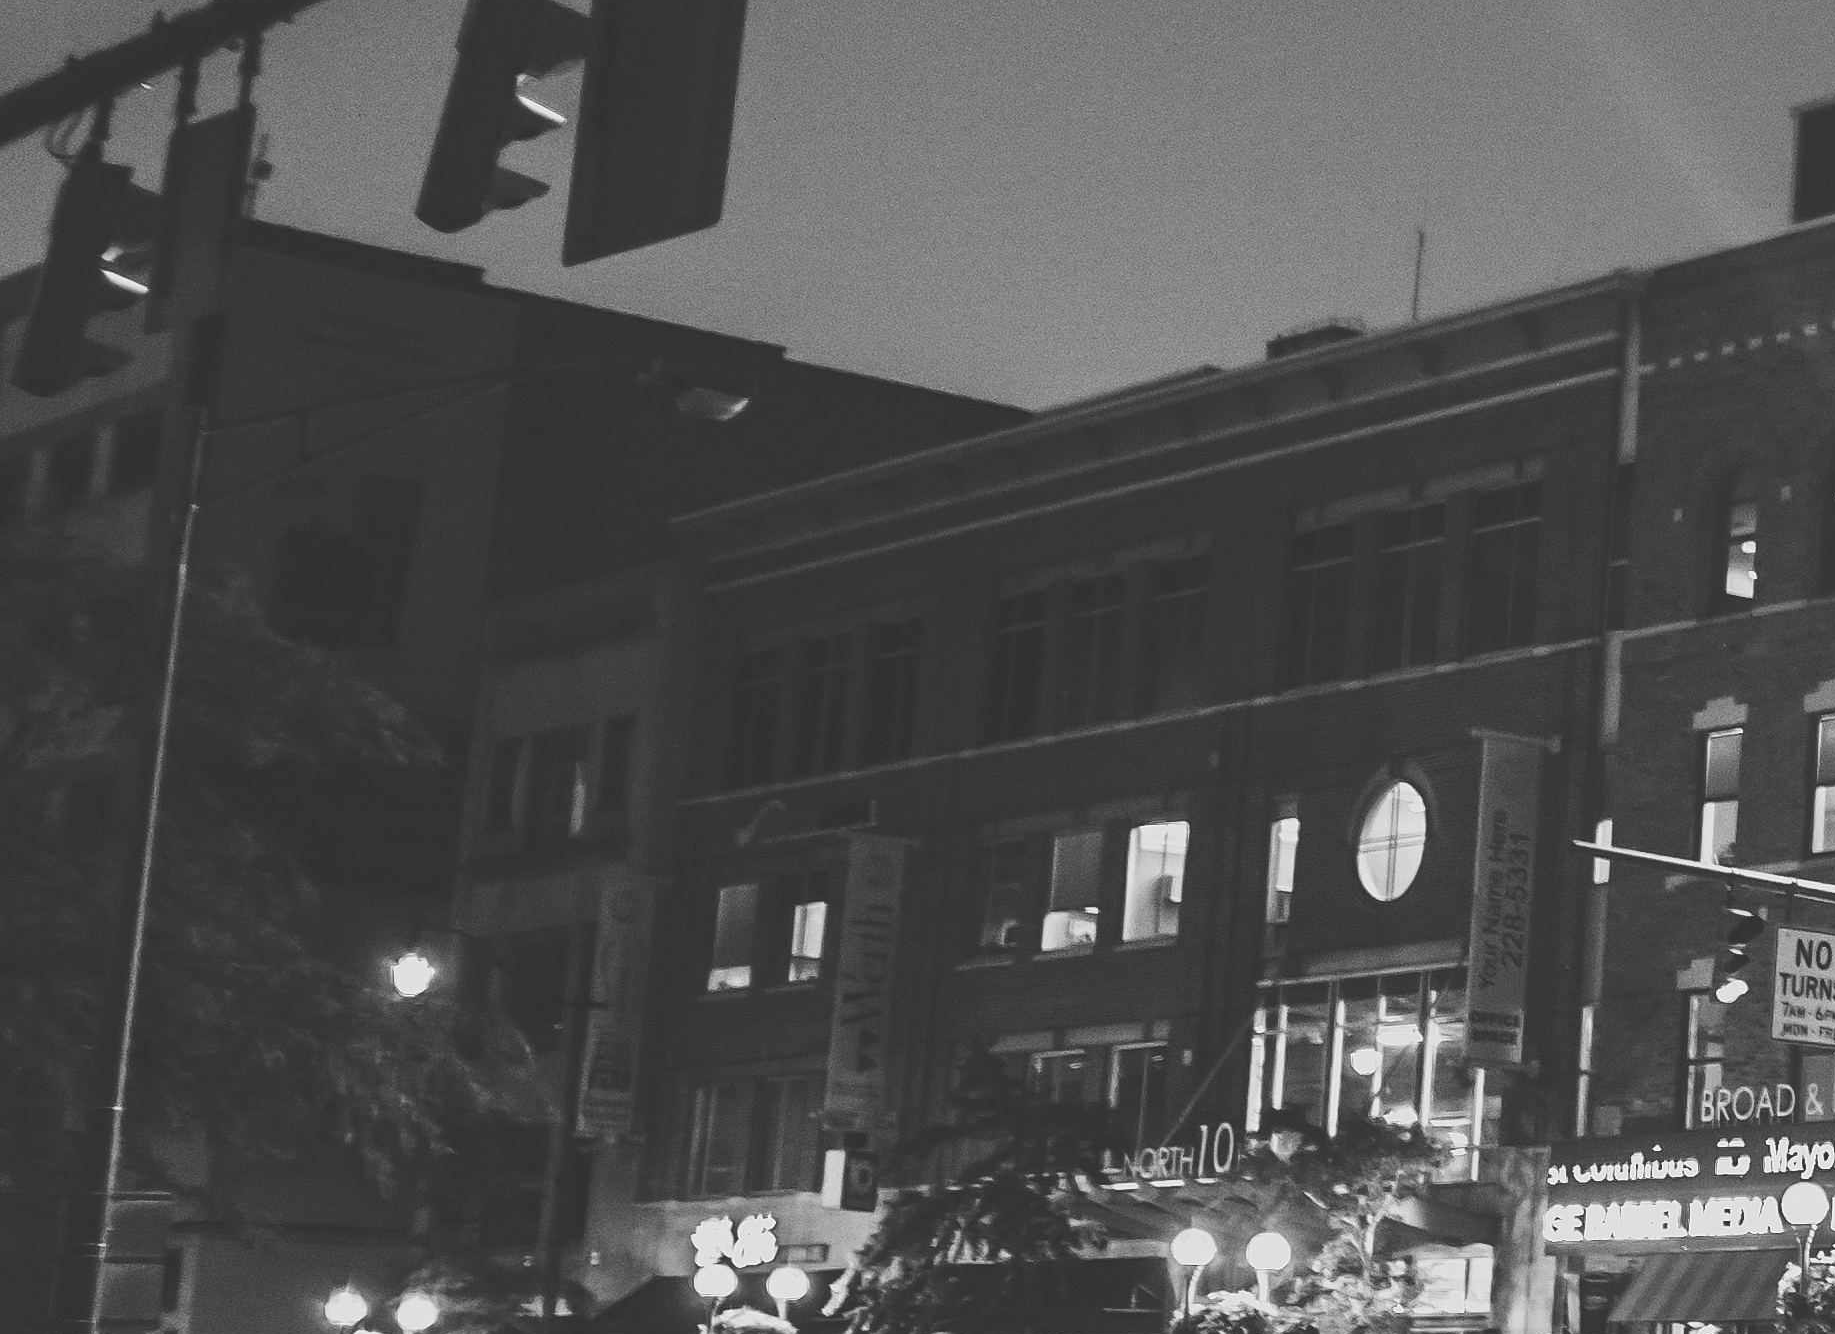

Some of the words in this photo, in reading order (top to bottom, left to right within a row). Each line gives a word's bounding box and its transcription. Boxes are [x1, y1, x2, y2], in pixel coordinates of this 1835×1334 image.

[1483, 870, 1504, 936] Name
[1479, 943, 1498, 990] Your
[1795, 938, 1833, 970] NO
[1700, 1083, 1796, 1125] BROAD
[1805, 1085, 1825, 1118] &
